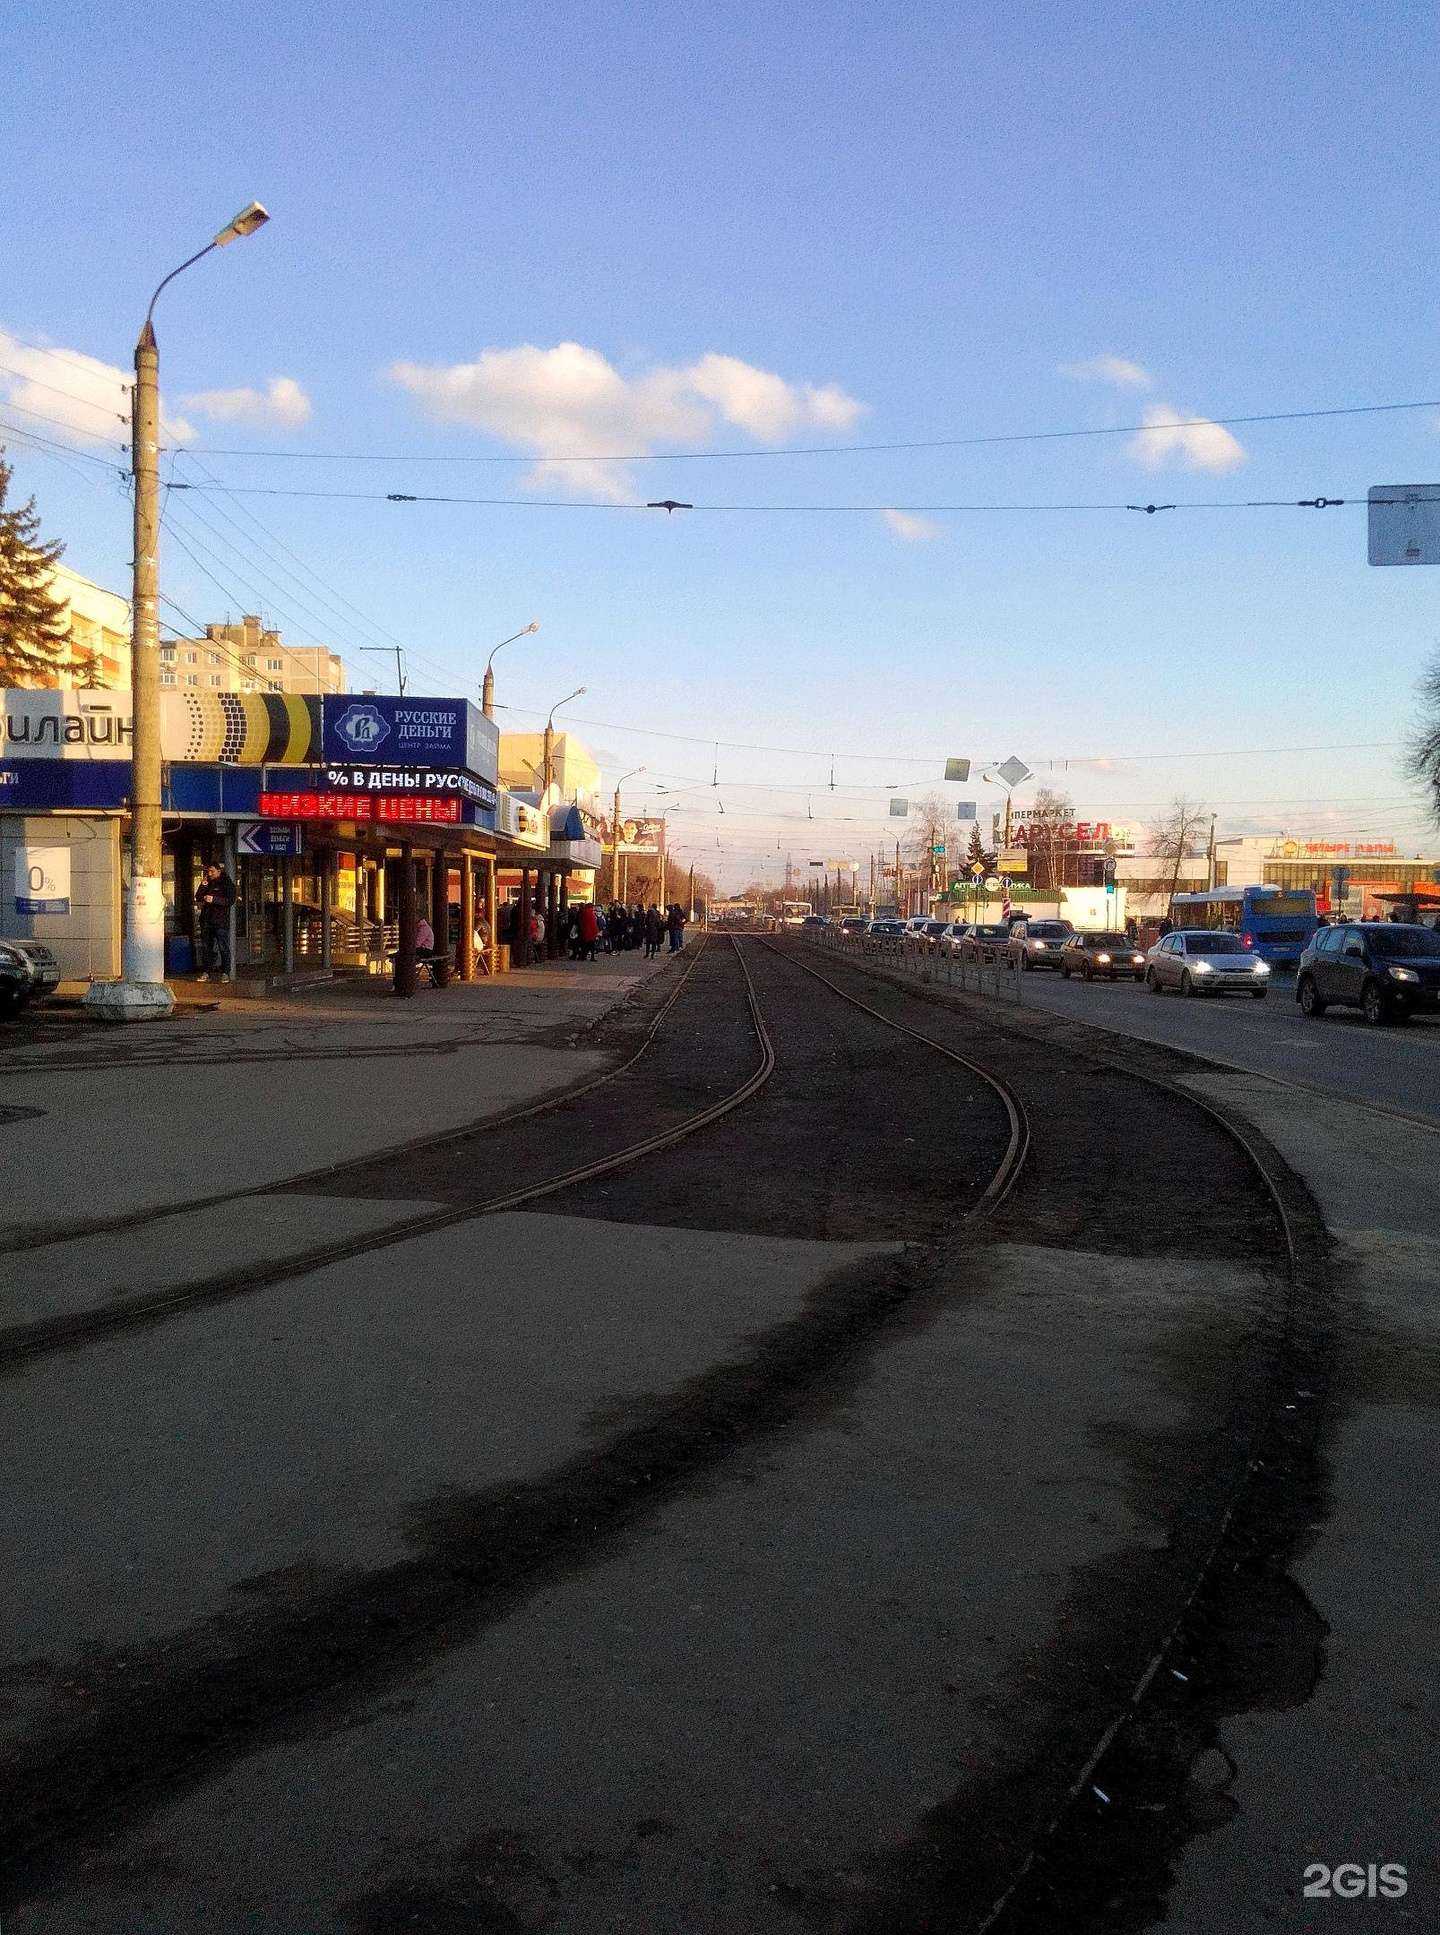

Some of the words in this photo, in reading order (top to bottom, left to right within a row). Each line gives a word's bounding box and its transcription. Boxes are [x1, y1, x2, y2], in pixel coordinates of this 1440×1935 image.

[0, 704, 134, 743] илайн
[394, 710, 457, 725] РУССКИЕ
[398, 724, 453, 739] ДЕНЬГИ
[328, 770, 349, 786] %
[353, 771, 365, 787] В
[368, 772, 420, 790] ДЕНЬ!
